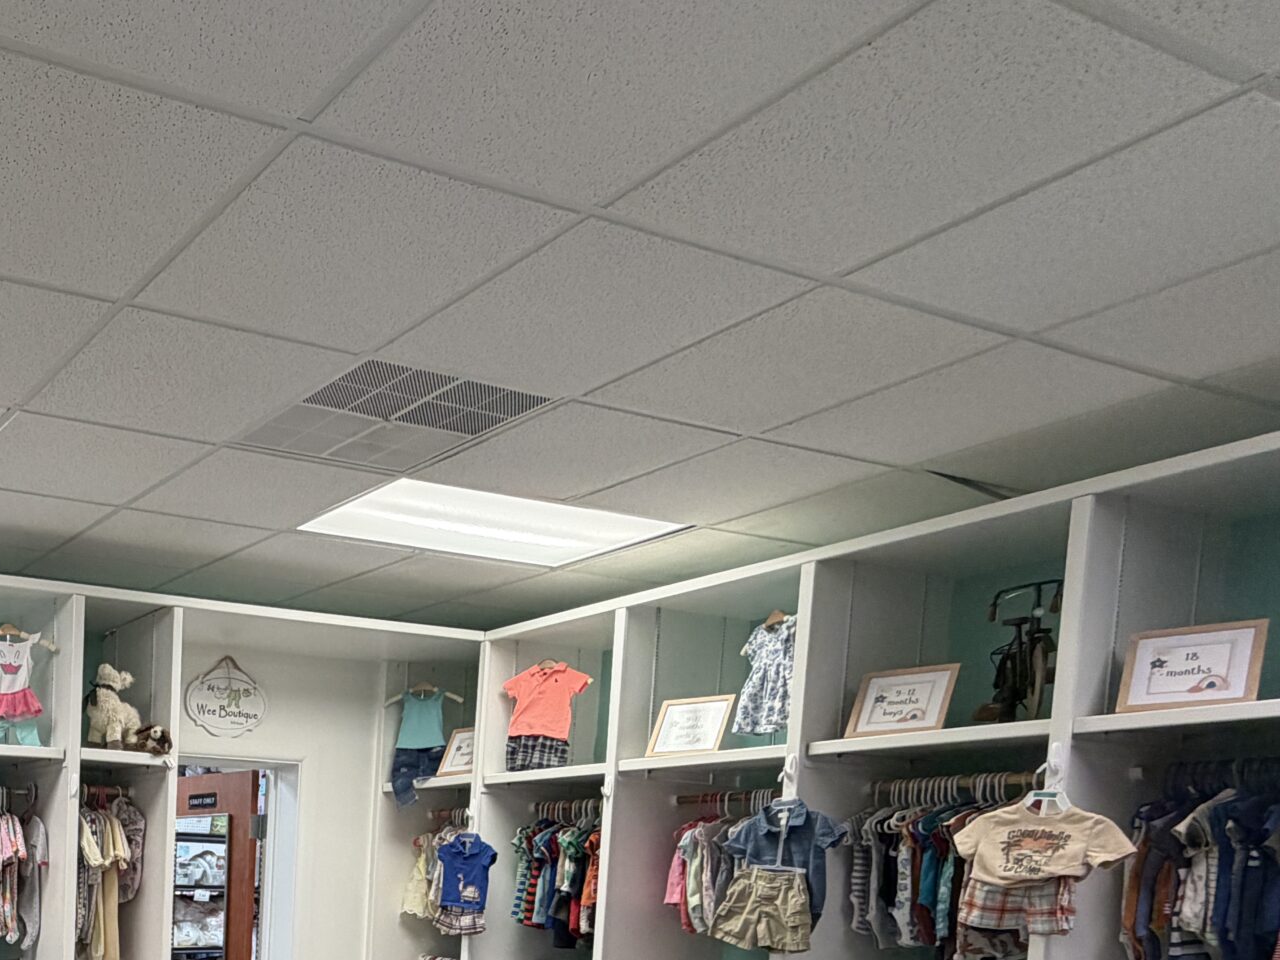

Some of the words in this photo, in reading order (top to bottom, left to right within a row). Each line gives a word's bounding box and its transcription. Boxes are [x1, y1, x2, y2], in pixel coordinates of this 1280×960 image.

[1185, 652, 1199, 661] 18
[1166, 665, 1212, 677] months
[887, 697, 919, 706] months
[197, 703, 217, 716] Wee
[219, 705, 259, 724] Boutique
[883, 708, 903, 718] boys
